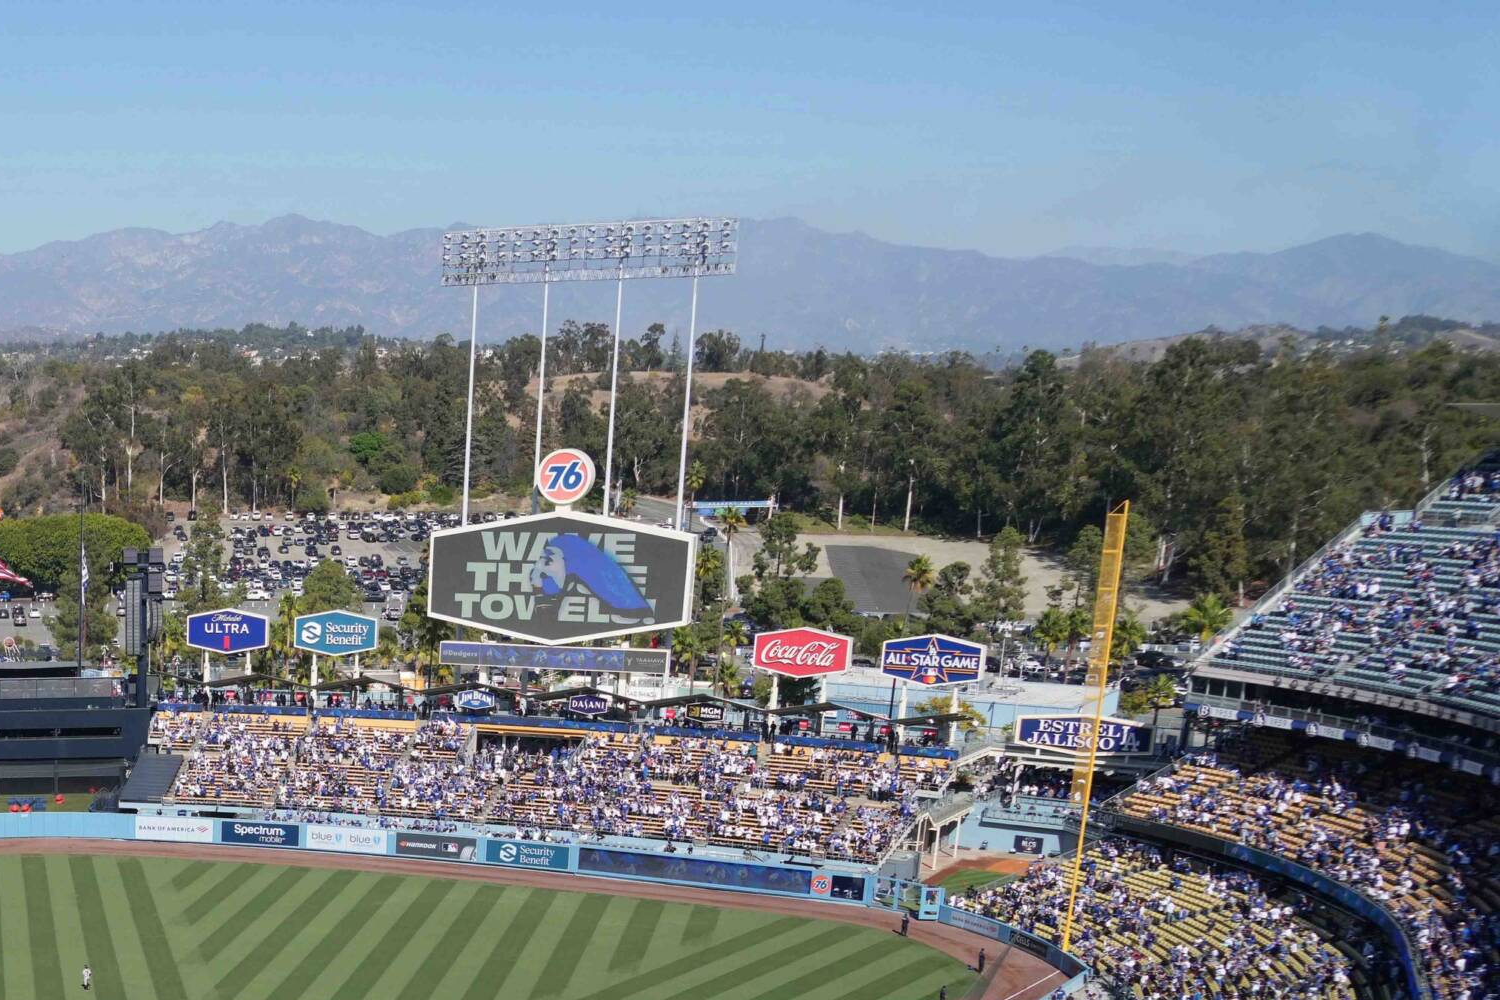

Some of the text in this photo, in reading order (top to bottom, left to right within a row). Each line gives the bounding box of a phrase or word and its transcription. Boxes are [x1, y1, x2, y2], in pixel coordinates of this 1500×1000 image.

[546, 460, 584, 492] 76
[204, 622, 250, 634] ULTRA
[325, 621, 369, 636] Security
[325, 633, 364, 645] Benefit
[886, 652, 979, 669] ALL STAR GAME
[572, 698, 605, 711] DASANI
[701, 706, 722, 715] MGM
[1027, 731, 1115, 751] JALISCO
[234, 823, 284, 838] Spectrum
[311, 832, 333, 841] blue
[258, 835, 284, 844] mobile
[349, 834, 371, 844] blue
[520, 846, 556, 857] Security
[520, 855, 550, 866] Benefit
[813, 879, 828, 890] 76
